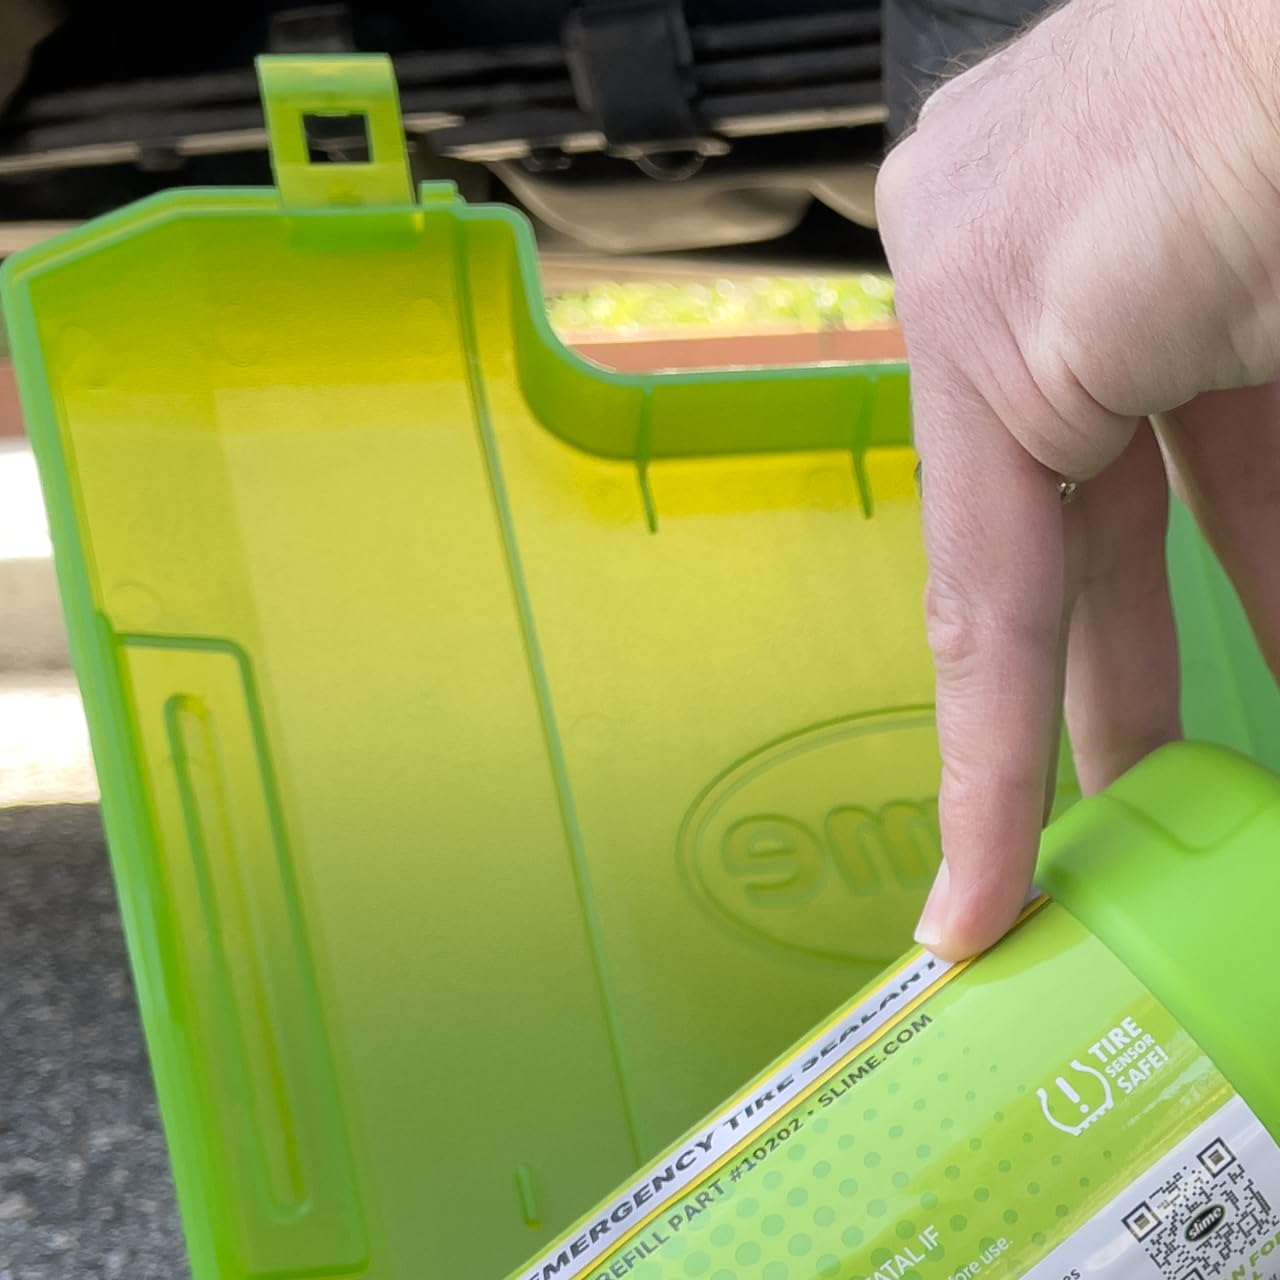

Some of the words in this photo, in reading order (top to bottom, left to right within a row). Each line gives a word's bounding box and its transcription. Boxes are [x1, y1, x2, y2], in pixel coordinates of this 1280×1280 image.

[722, 1073, 794, 1130] TIRE
[801, 960, 935, 1073] SEALANT
[1087, 1015, 1142, 1063] TIRE
[1104, 1033, 1155, 1077] SENSOR
[1116, 1044, 1169, 1094] SAFE!
[666, 1176, 724, 1232] PART
[729, 1116, 804, 1182] #10202
[816, 1013, 932, 1108] SLIME.COM
[917, 1224, 939, 1251] IF
[1188, 1206, 1222, 1240] slime
[978, 1236, 1009, 1264] use.
